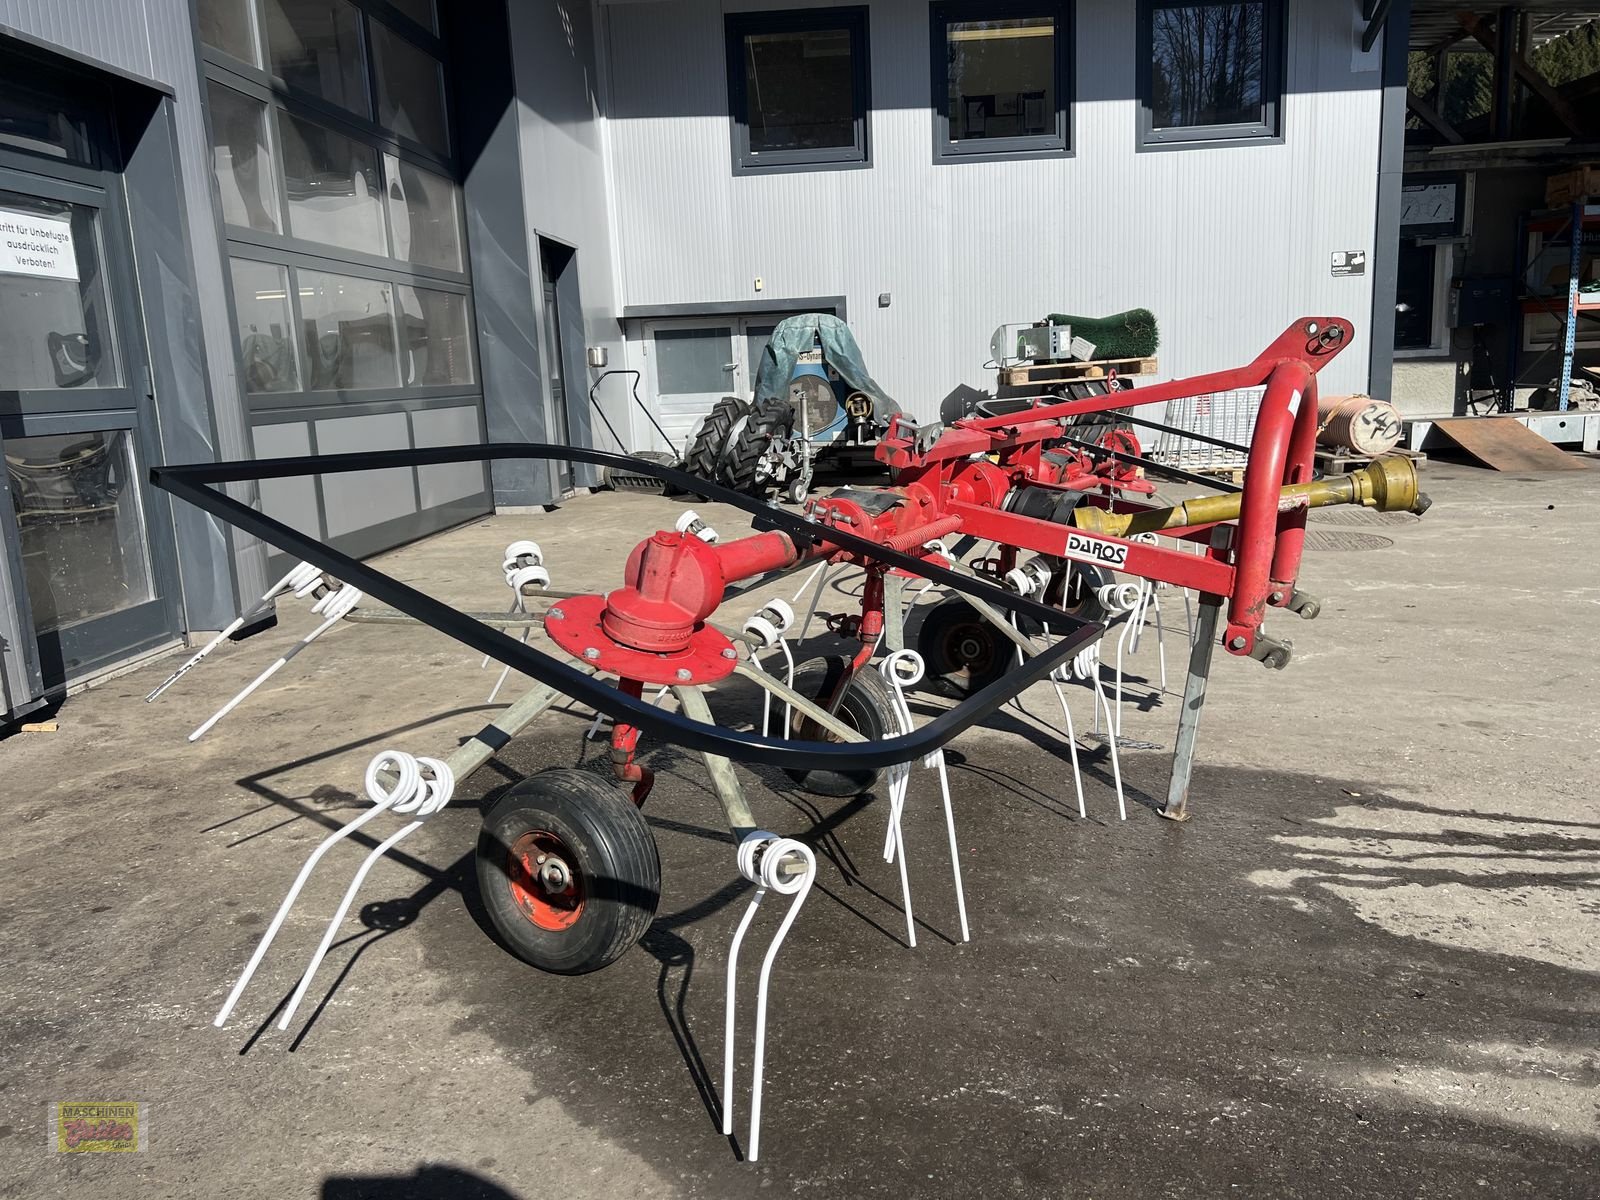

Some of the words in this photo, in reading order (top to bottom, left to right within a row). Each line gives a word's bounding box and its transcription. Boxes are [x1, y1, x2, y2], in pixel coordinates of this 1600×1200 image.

[16, 224, 28, 236] für
[29, 227, 69, 243] Unbefugte
[7, 239, 59, 255] ausdrücklich
[16, 255, 55, 269] Verboten!
[1068, 536, 1126, 565] DAROS
